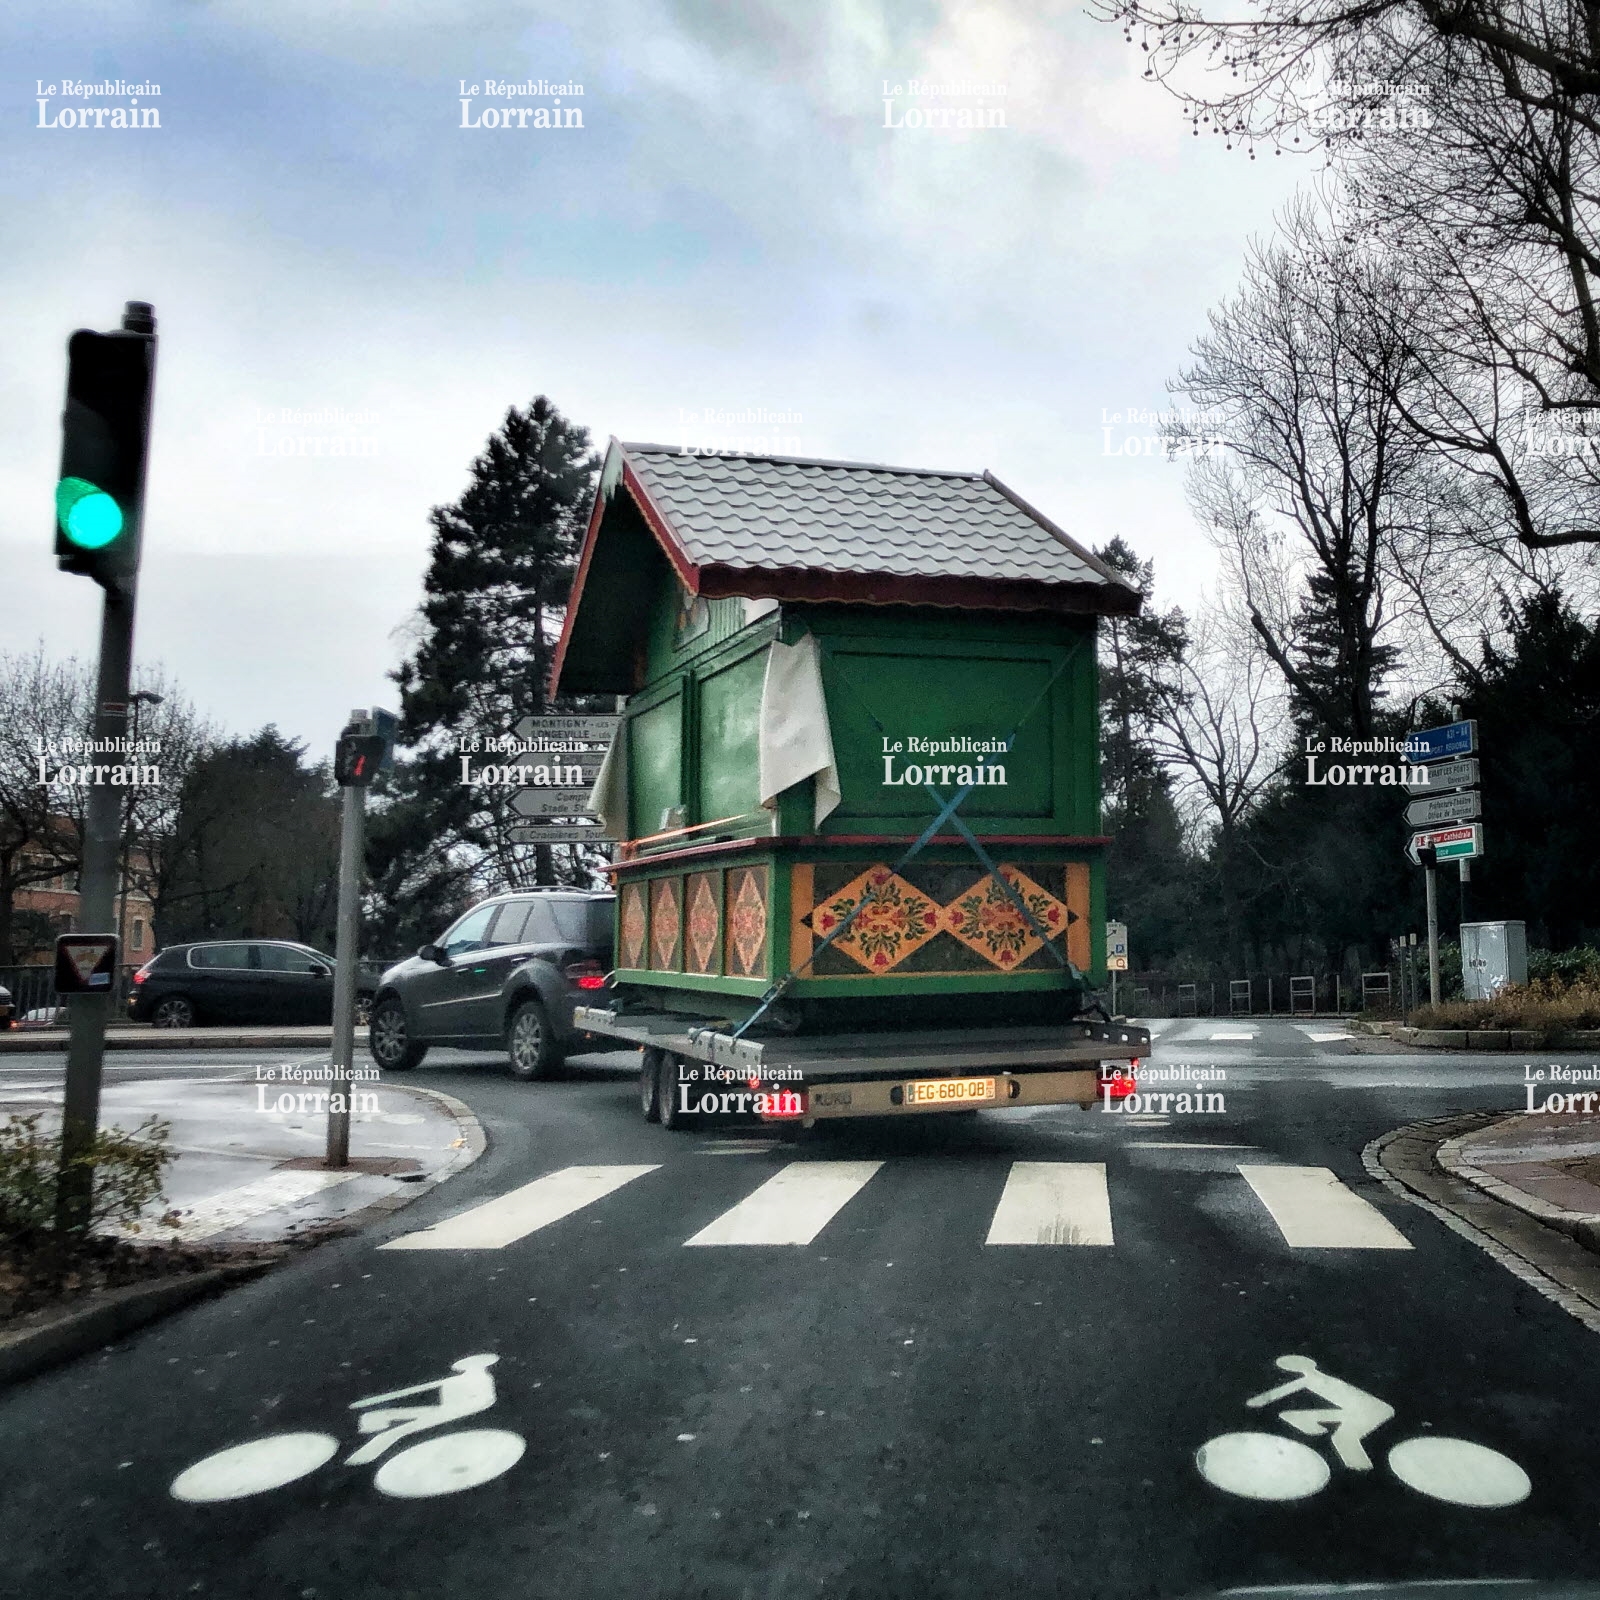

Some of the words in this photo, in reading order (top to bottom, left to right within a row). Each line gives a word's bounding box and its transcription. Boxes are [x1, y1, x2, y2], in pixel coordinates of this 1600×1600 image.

[532, 718, 588, 728] MONTIGNY
[531, 729, 590, 739] LONGEVILLE
[1427, 768, 1443, 779] EVANT
[1443, 830, 1471, 841] Cathédrale
